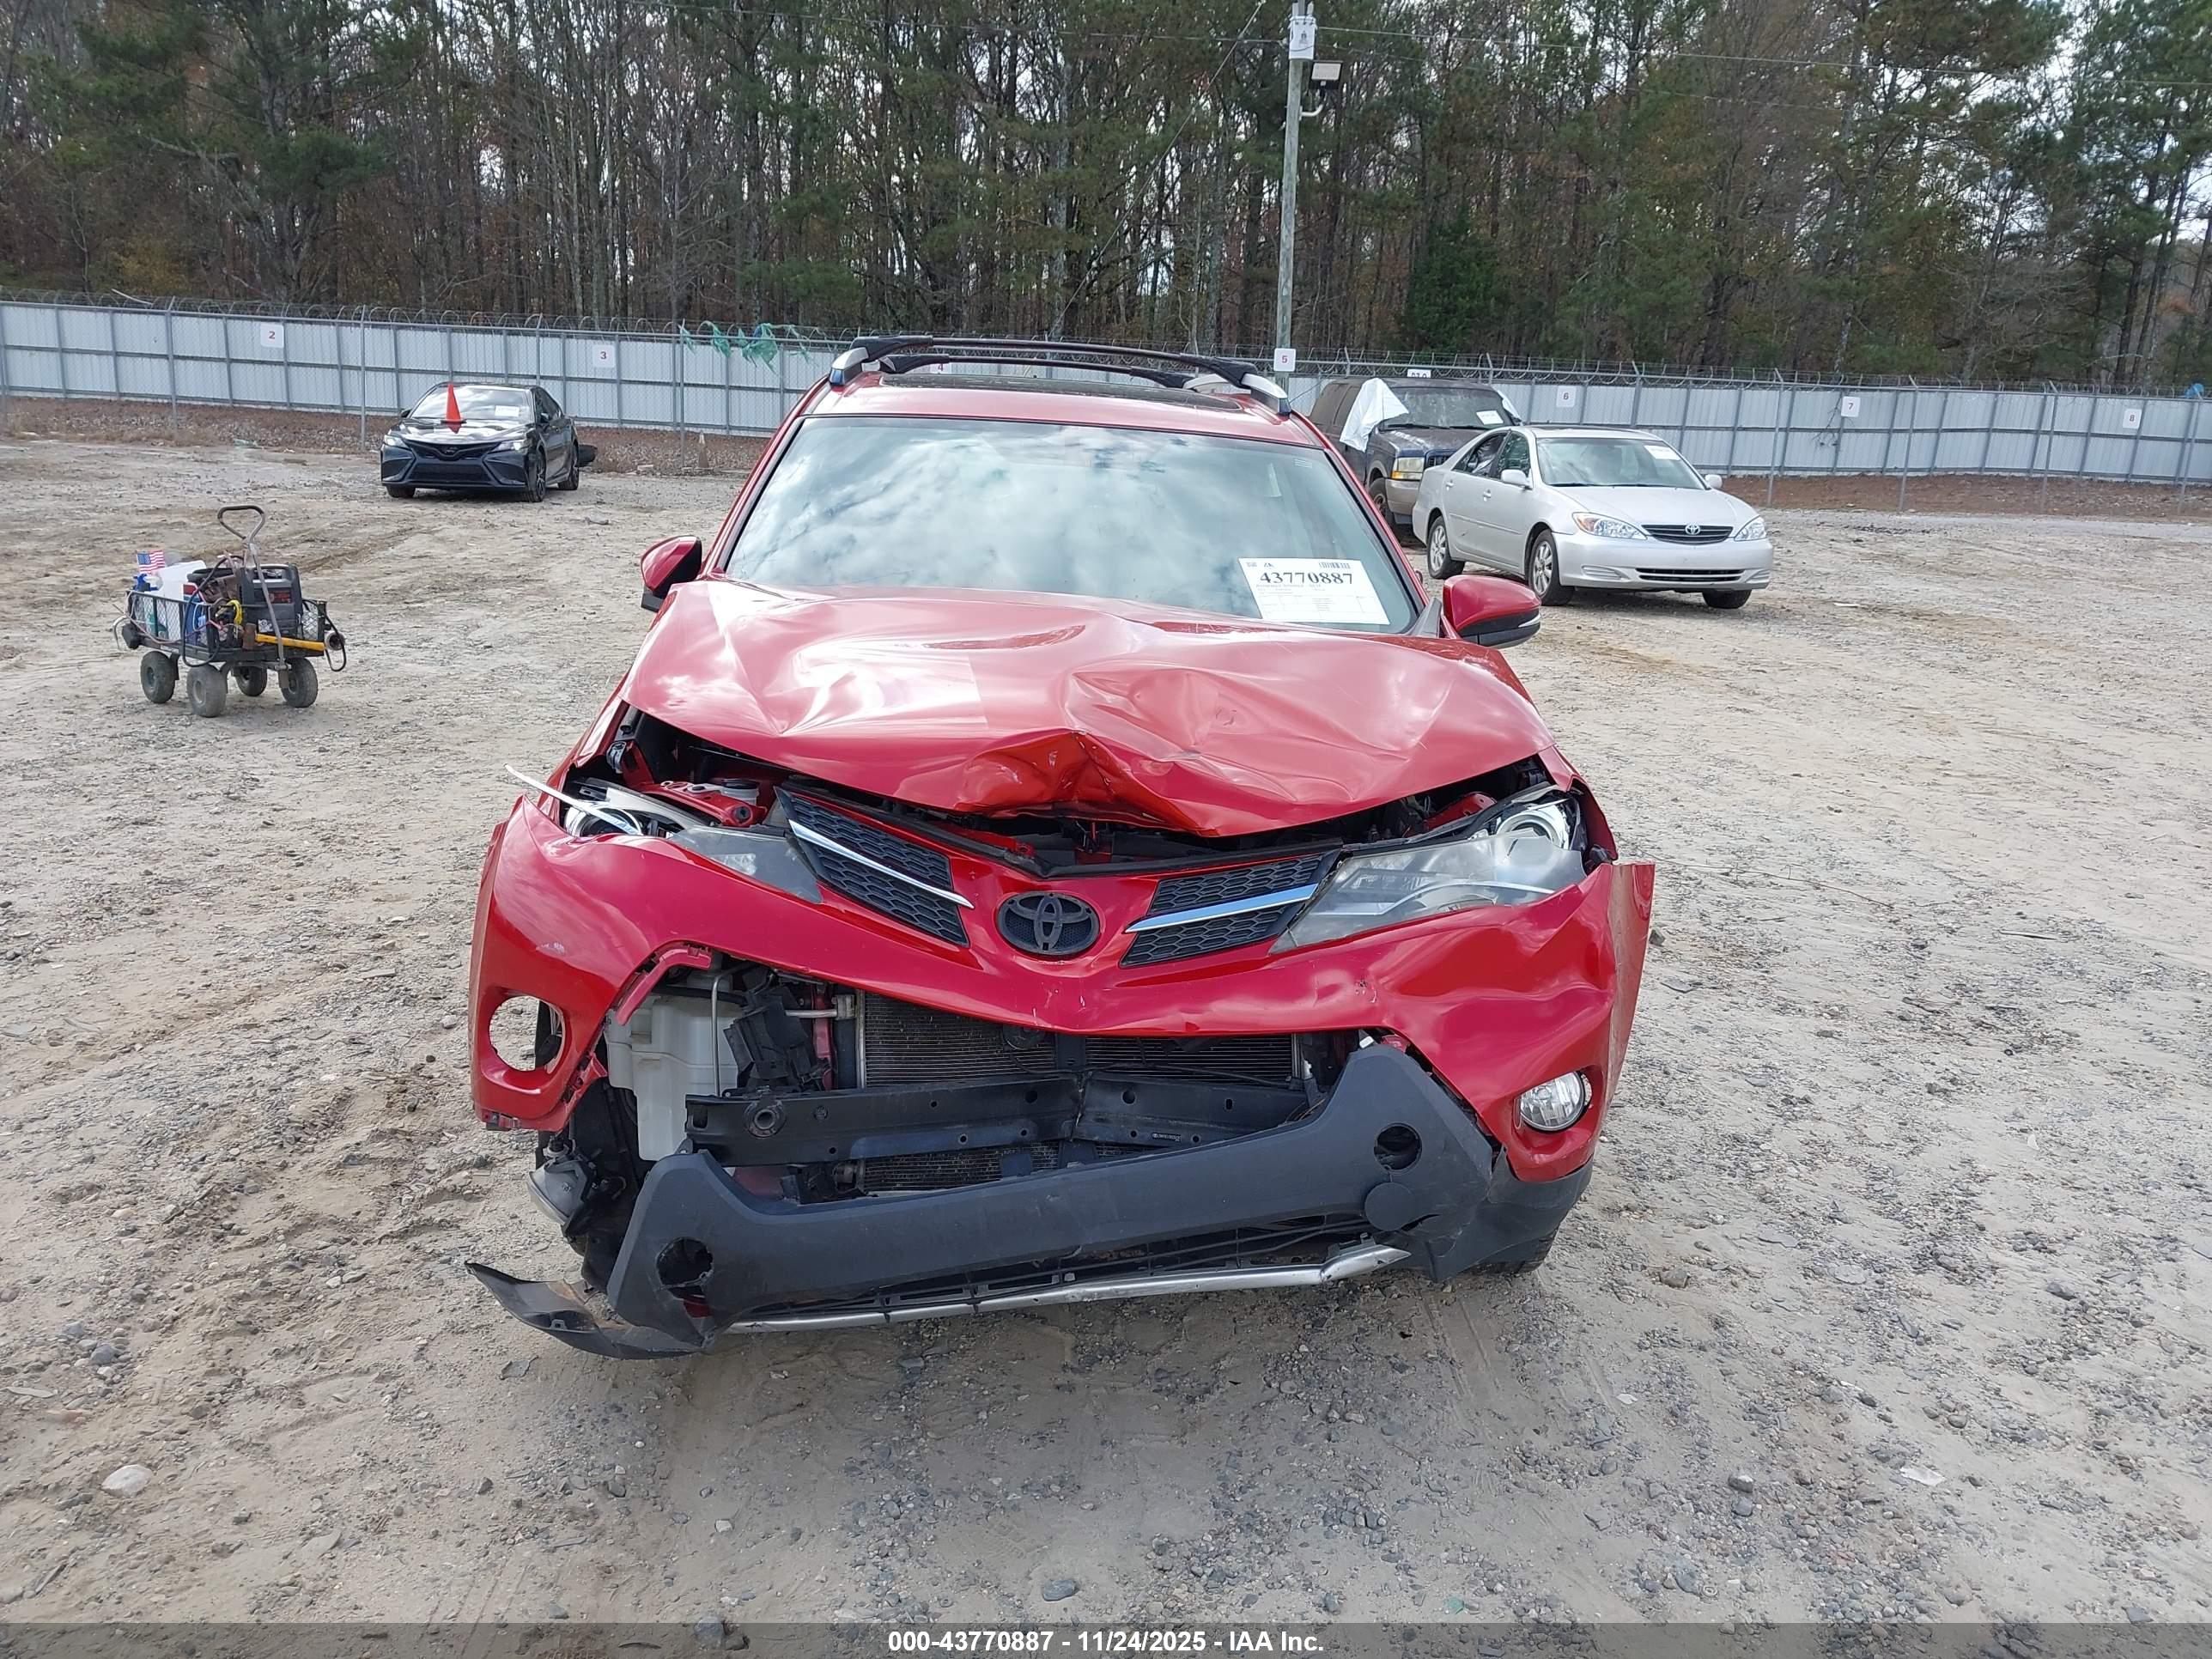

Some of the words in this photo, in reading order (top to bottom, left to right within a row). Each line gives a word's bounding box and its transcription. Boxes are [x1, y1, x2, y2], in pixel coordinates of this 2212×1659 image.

[268, 331, 276, 339] 2
[600, 351, 606, 360] 3
[1563, 392, 1570, 400] 6
[1259, 572, 1352, 585] 43770887
